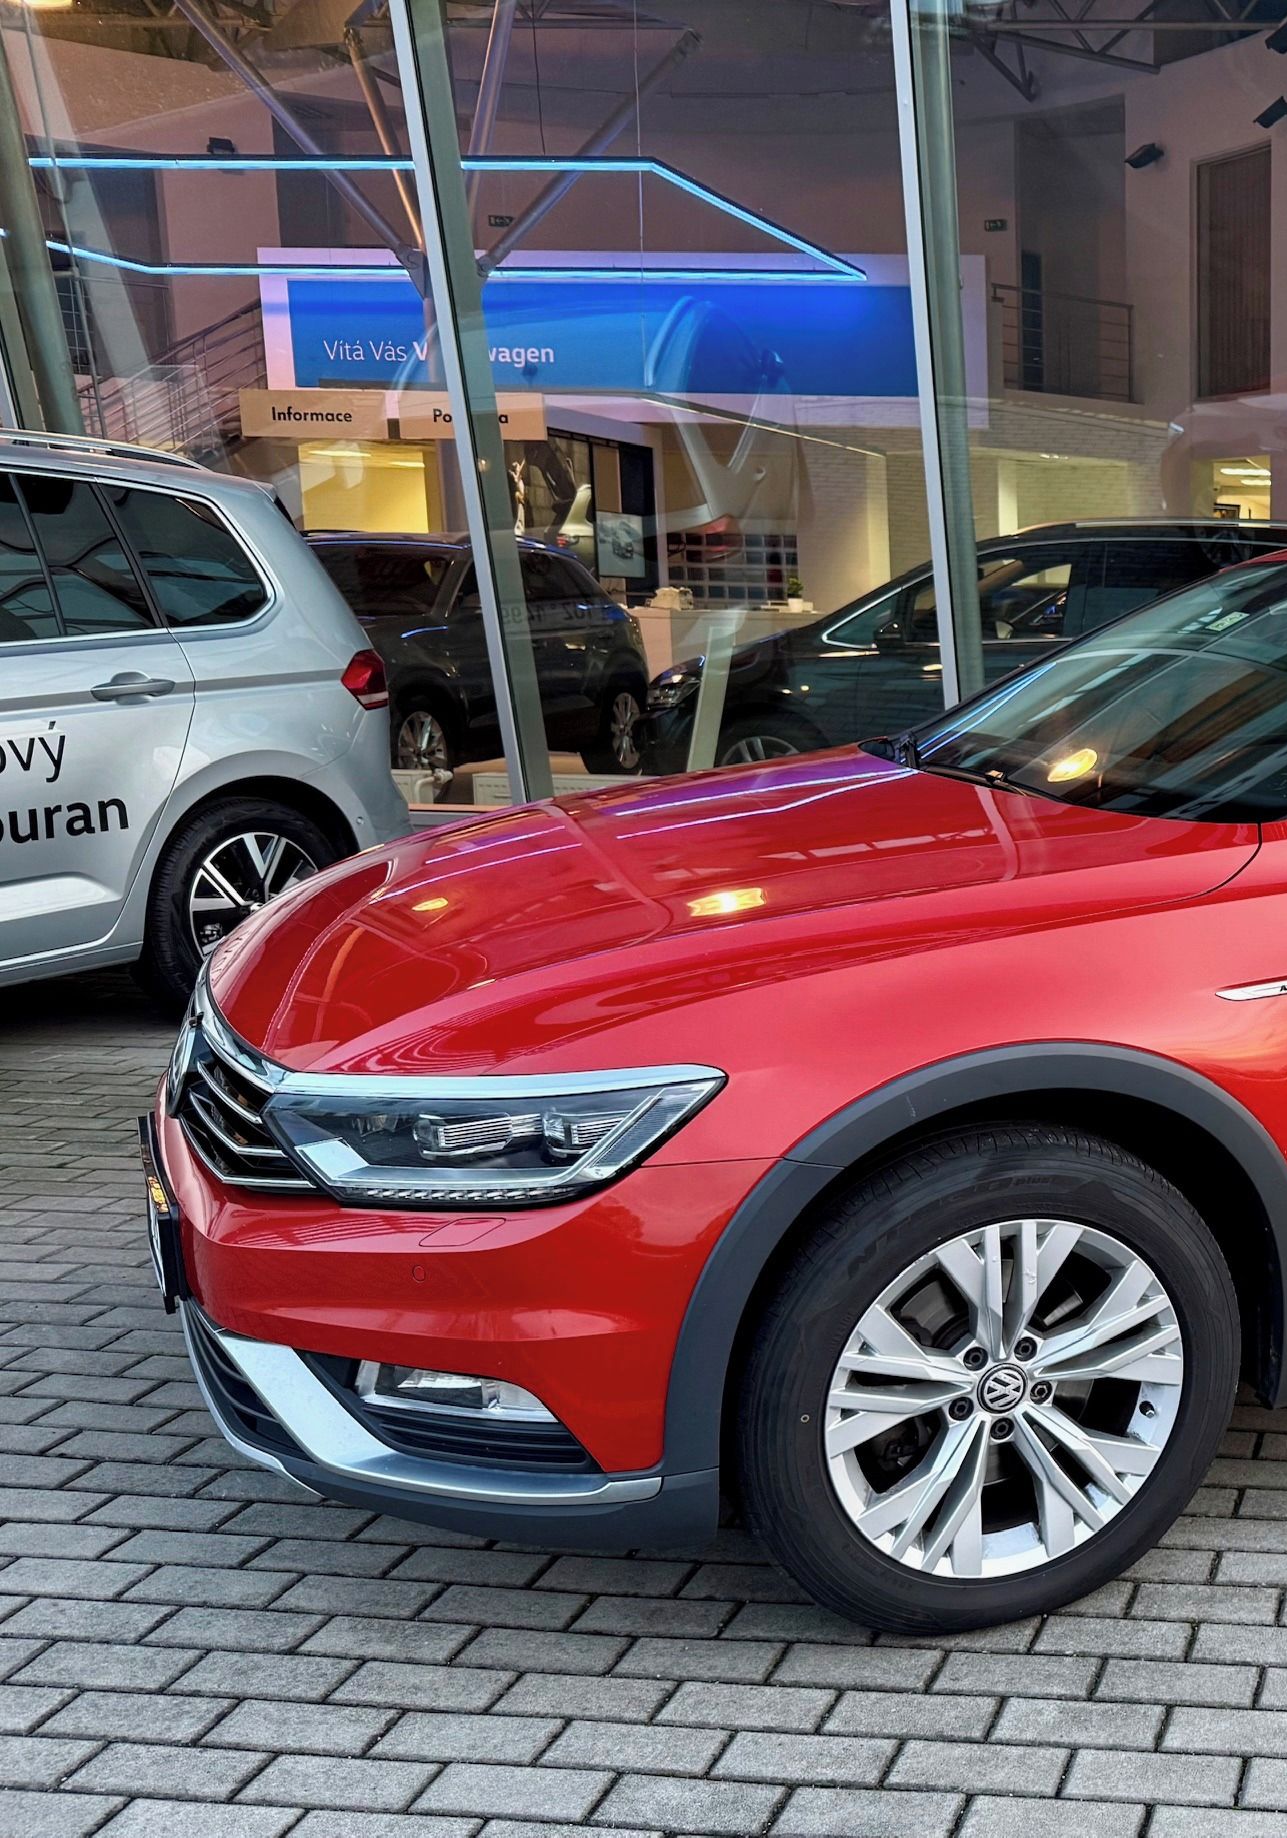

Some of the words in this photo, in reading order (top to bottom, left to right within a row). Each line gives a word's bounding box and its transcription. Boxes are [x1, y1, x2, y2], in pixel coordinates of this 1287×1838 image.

[323, 340, 365, 361] Vítá
[369, 340, 407, 361] Vás
[271, 406, 353, 423] Informace
[0, 720, 66, 783] vý
[0, 798, 129, 844] uran
